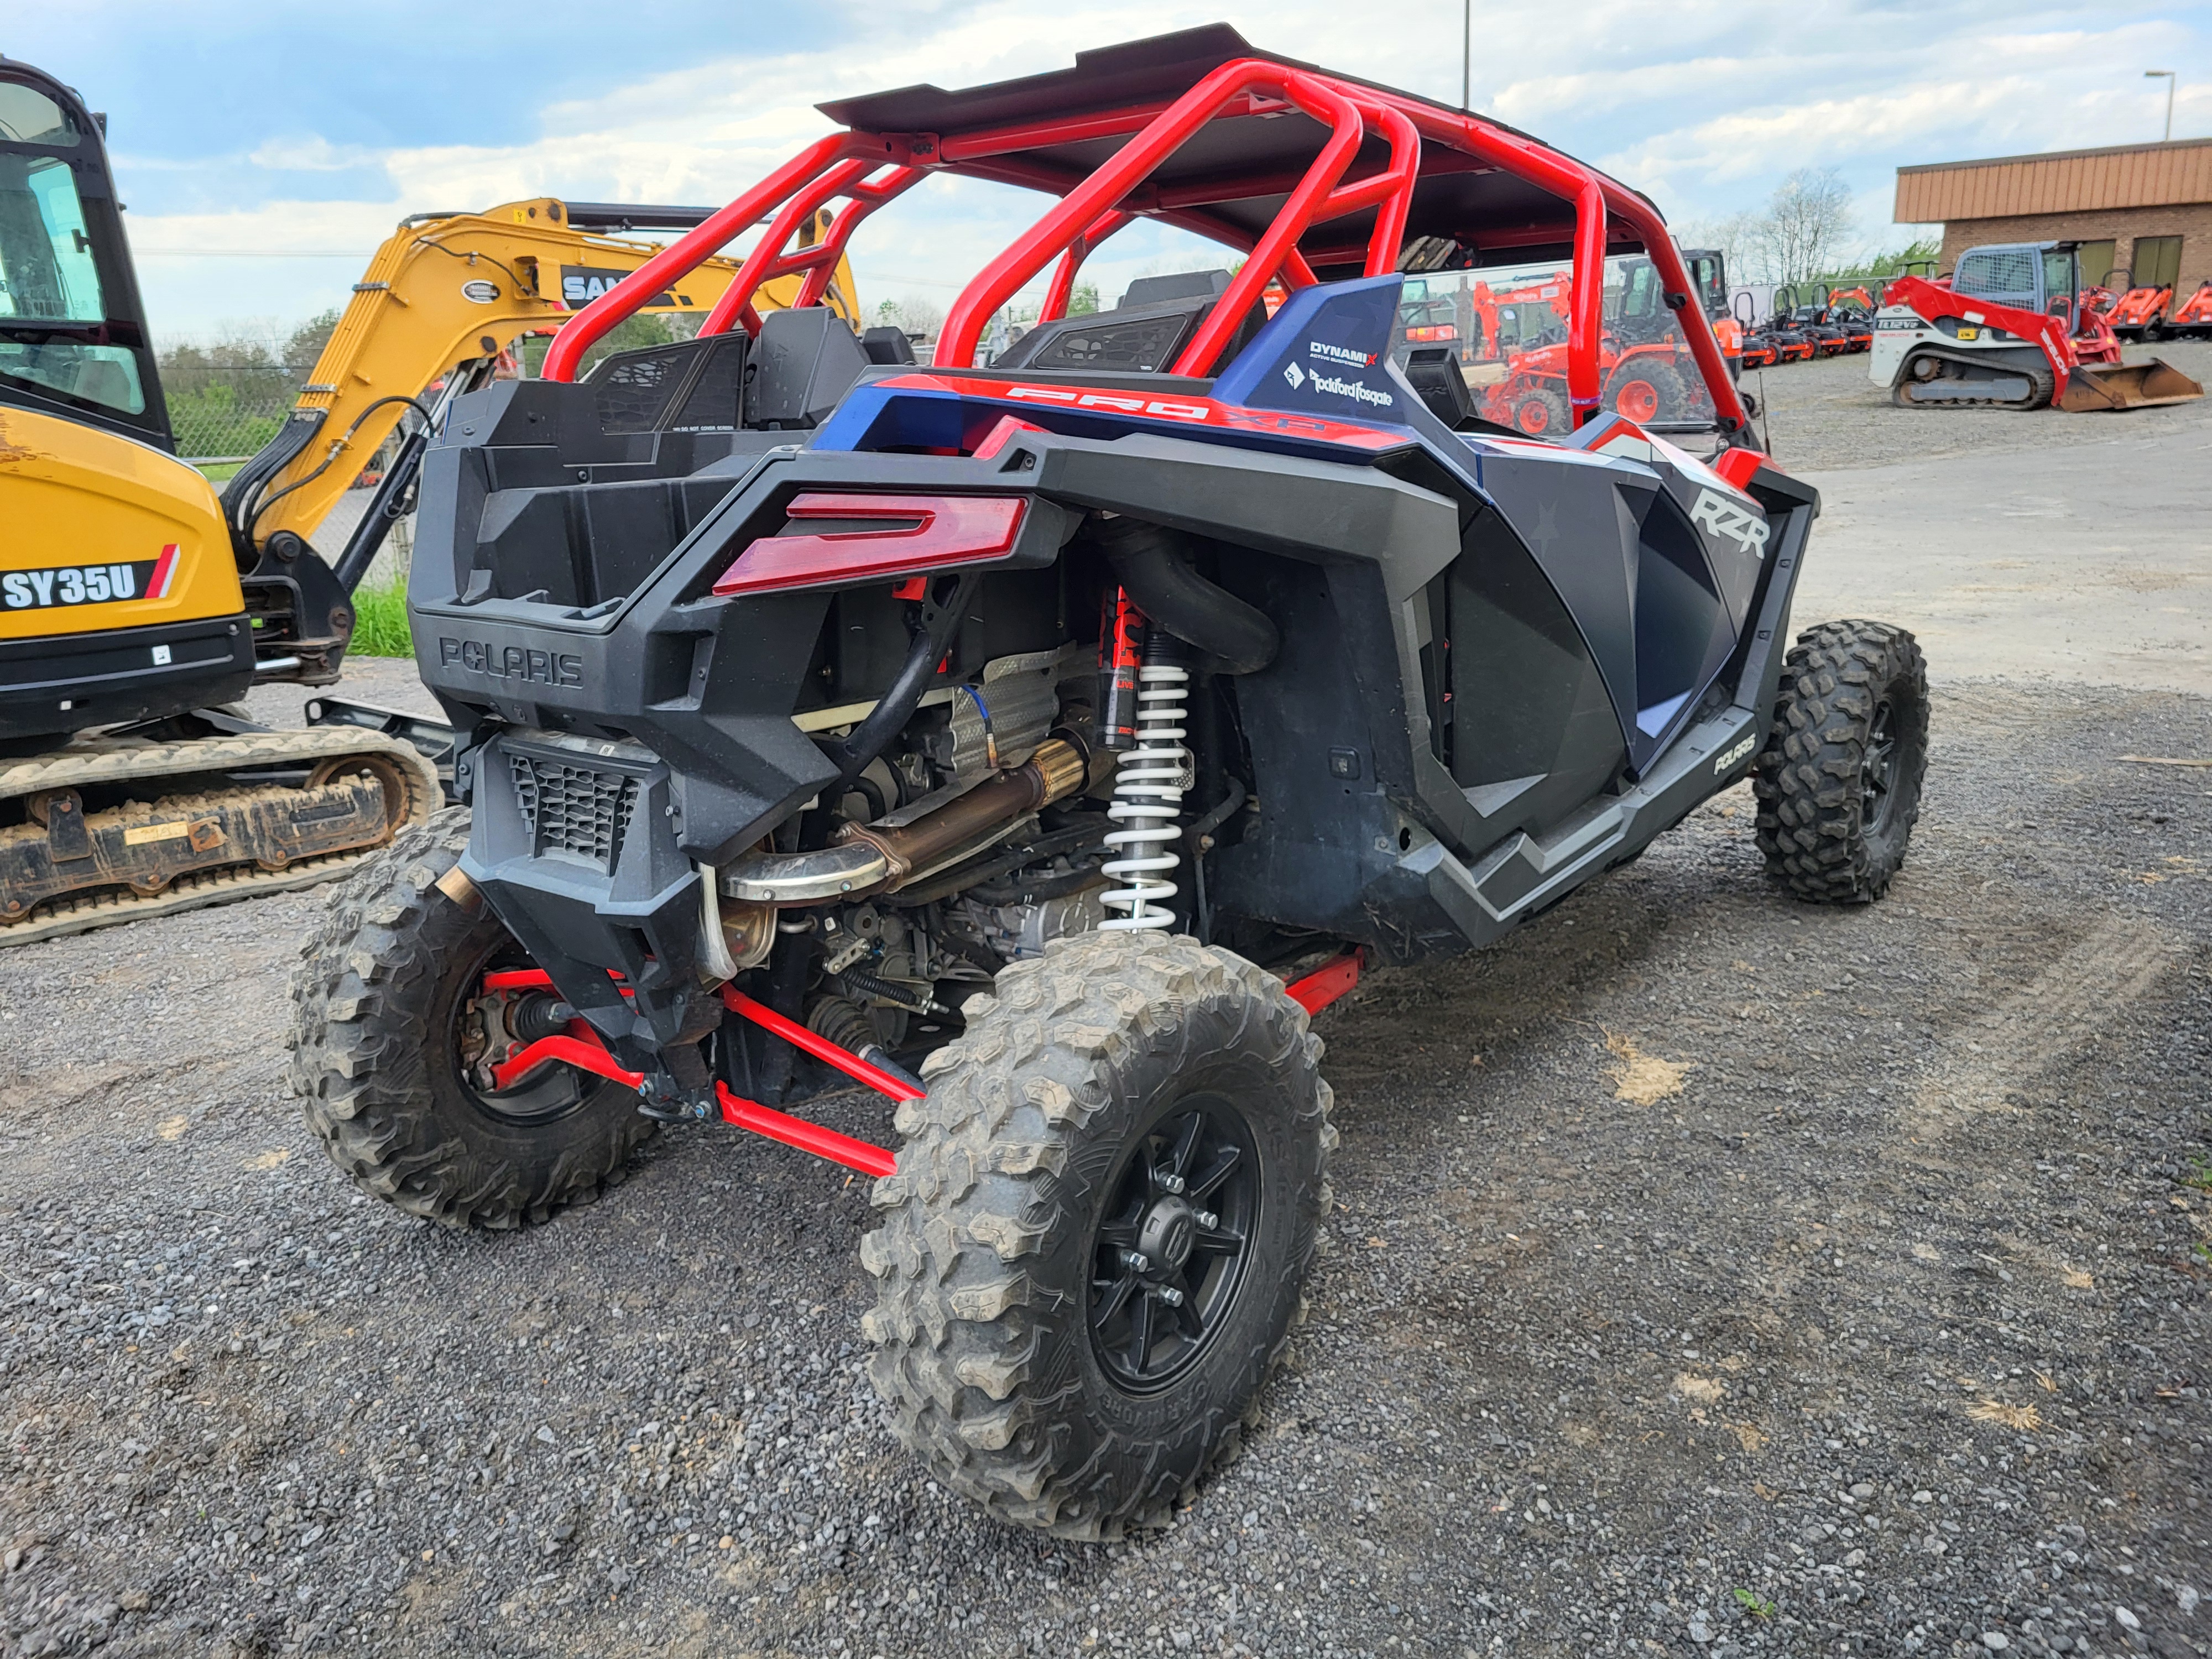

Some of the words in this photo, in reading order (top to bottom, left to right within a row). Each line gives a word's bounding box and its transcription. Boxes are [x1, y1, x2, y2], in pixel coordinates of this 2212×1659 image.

[563, 276, 625, 300] SA
[1310, 341, 1378, 367] DYNAMIX
[1310, 353, 1330, 361] ACTIVE
[1006, 387, 1210, 420] PRO
[1689, 487, 1771, 560] RZR
[3, 564, 135, 608] SY35U
[439, 637, 583, 690] POLARIS
[1713, 732, 1757, 776] POLARIS
